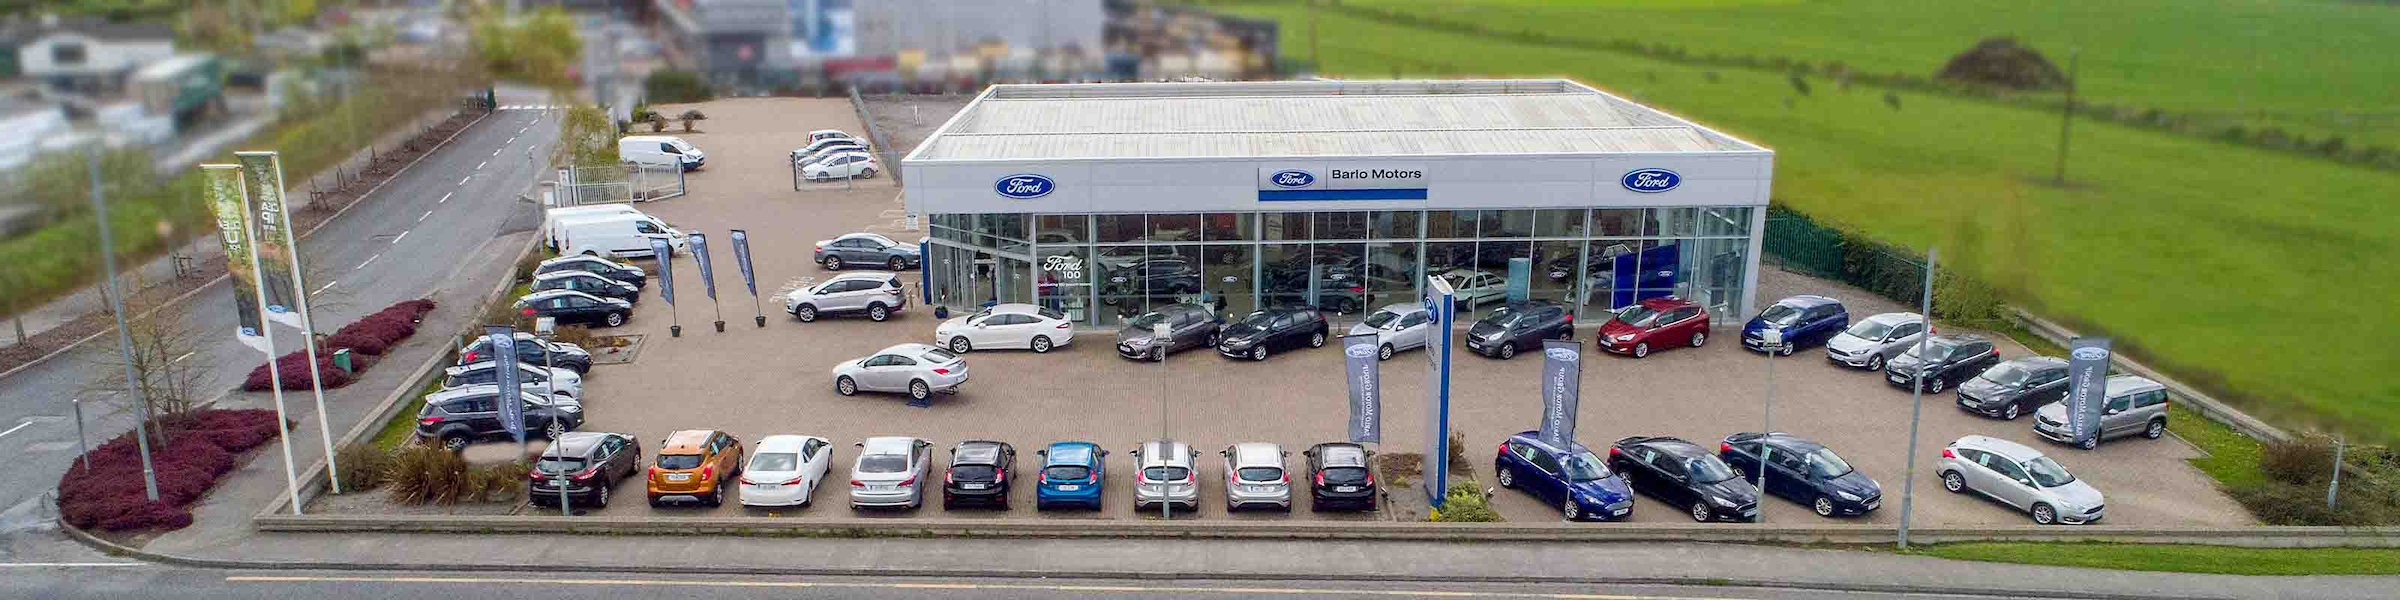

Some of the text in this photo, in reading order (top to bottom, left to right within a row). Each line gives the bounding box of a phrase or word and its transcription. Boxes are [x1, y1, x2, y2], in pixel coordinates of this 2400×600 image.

[1278, 171, 1306, 185] Ford
[1332, 169, 1422, 179] Barlo Motors
[1634, 172, 1670, 187] Ford
[1006, 178, 1043, 193] Ford
[1043, 255, 1083, 271] Ford
[1062, 271, 1081, 279] 100
